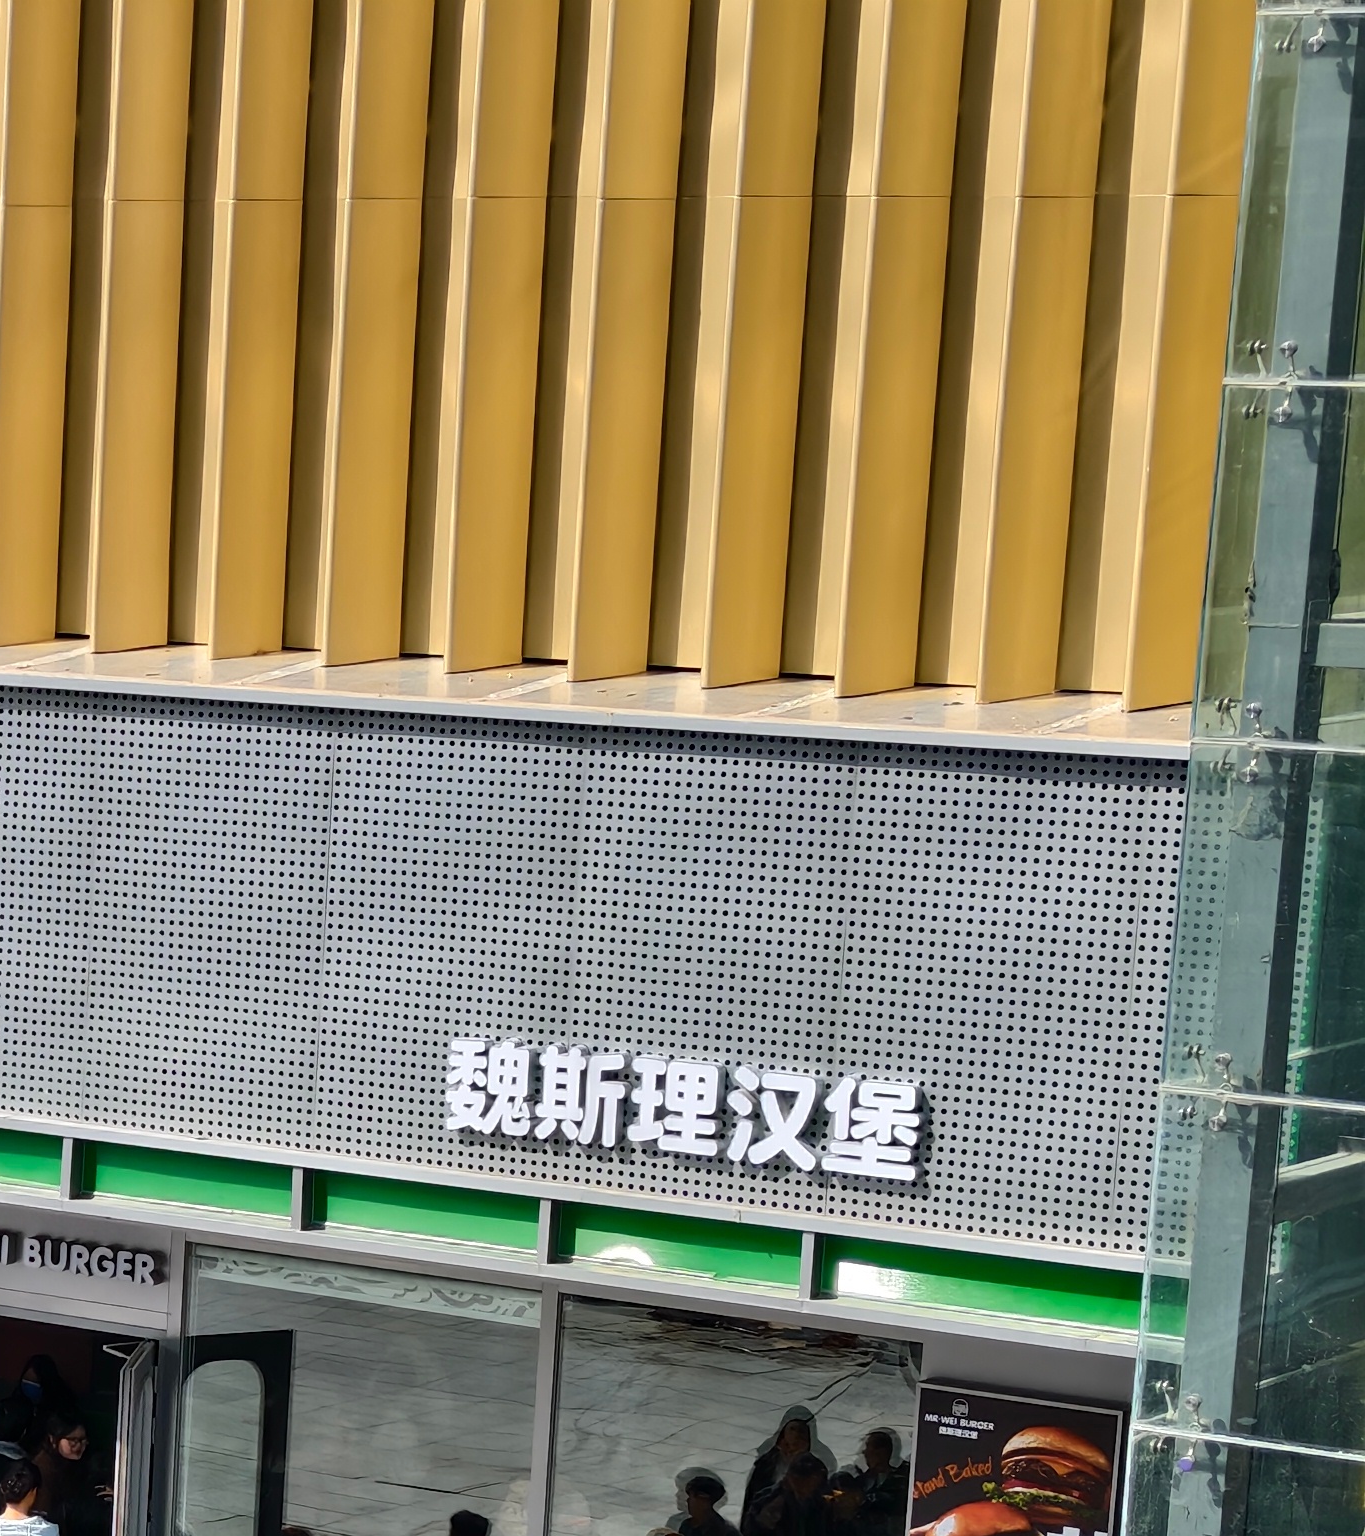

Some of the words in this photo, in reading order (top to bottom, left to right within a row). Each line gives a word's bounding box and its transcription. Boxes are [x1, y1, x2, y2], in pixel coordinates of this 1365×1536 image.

[445, 1037, 923, 1182] 魏斯理汉堡
[22, 1237, 155, 1287] BURGER
[959, 1418, 995, 1431] BURGER
[944, 1455, 992, 1483] Baked
